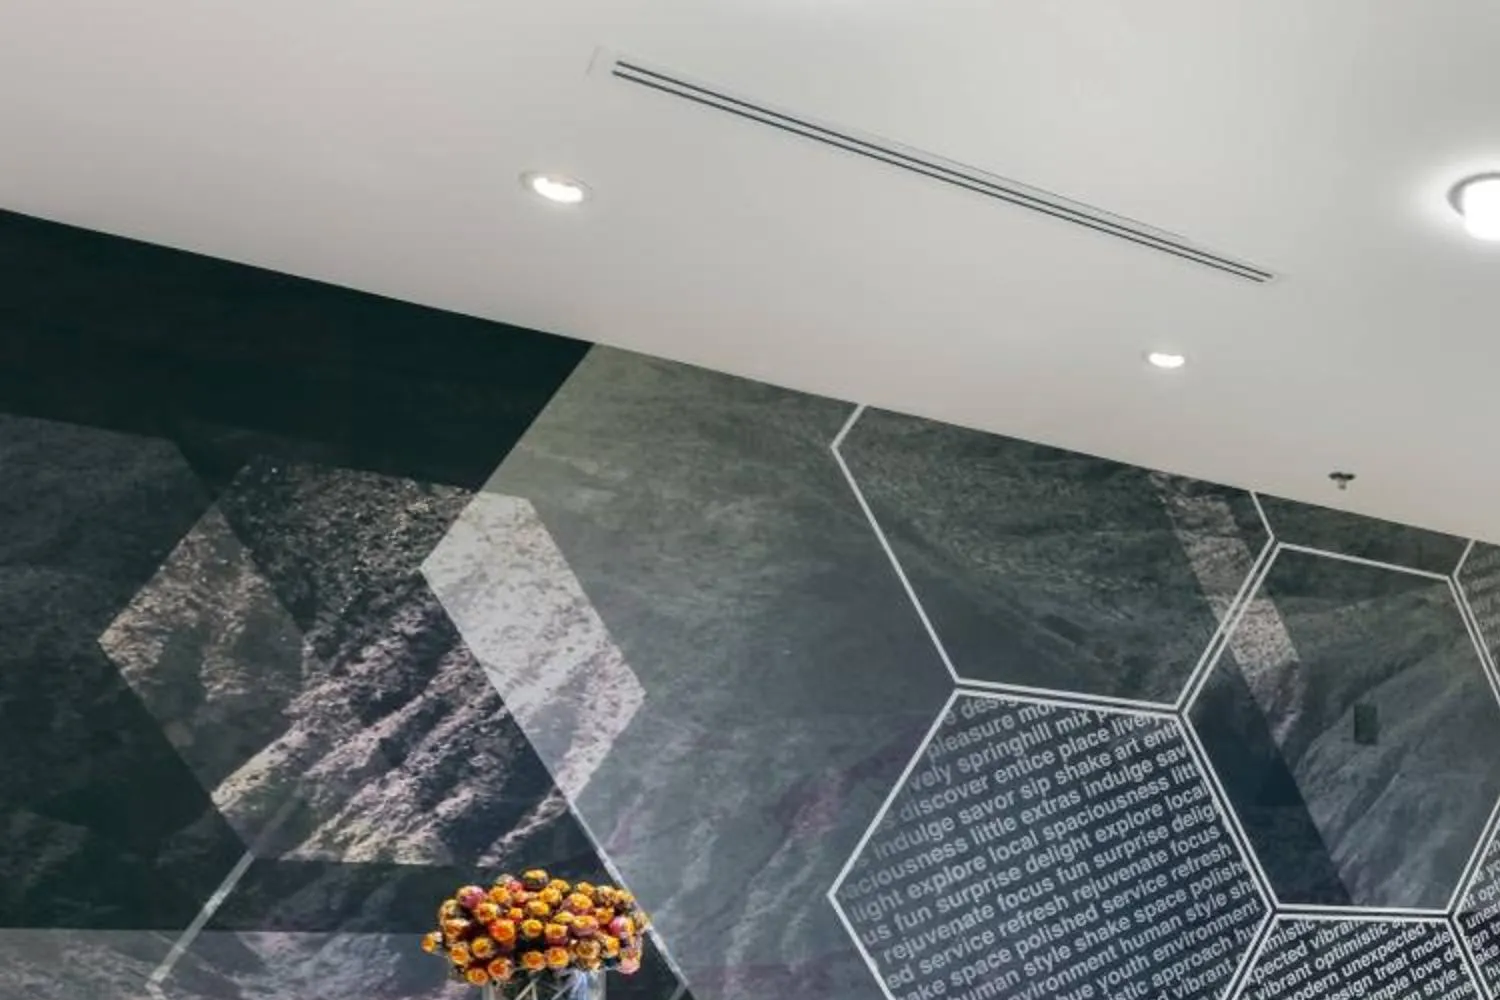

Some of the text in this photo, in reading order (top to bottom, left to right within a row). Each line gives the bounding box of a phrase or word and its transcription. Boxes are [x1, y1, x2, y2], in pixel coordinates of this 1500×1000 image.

[896, 775, 991, 823] discover
[993, 749, 1056, 784] entice
[1057, 727, 1112, 763] place
[925, 714, 1015, 765] pleasure
[956, 720, 1053, 773] springhill
[1054, 709, 1092, 735] mix
[871, 816, 956, 860] indulge
[957, 790, 1017, 825] savor
[1018, 776, 1054, 799] sip
[1053, 751, 1113, 786] shake
[1113, 735, 1141, 760] art
[968, 816, 1018, 845] little
[1019, 788, 1082, 825] extras
[1081, 758, 1154, 798] indulge
[892, 905, 933, 931] fun
[934, 865, 1024, 914] surprise
[1021, 831, 1093, 874] delight
[1093, 802, 1165, 843] explore
[906, 855, 988, 900] explore
[987, 827, 1039, 863] local
[1042, 775, 1170, 841] spaciousness
[883, 903, 996, 965] rejuvenate
[994, 876, 1056, 912] focus
[1053, 860, 1091, 885] fun
[1092, 824, 1170, 869] surprise
[918, 929, 997, 975] service
[997, 890, 1070, 937] refresh
[1071, 848, 1170, 903] rejuvenate
[1167, 824, 1221, 857] focus
[949, 947, 1014, 987] space
[1014, 901, 1099, 960] polished
[1100, 872, 1169, 914] service
[1169, 837, 1232, 881] refresh
[1117, 913, 1183, 954] human
[1183, 891, 1228, 922] style
[1022, 944, 1073, 978] style
[1073, 915, 1132, 953] shake
[1132, 887, 1188, 924] space
[1095, 949, 1150, 995] youth
[1150, 893, 1261, 961] environment
[1149, 930, 1233, 988] approach
[1314, 920, 1389, 971] optimistic
[1341, 921, 1426, 977] unexpected
[1374, 950, 1410, 981] treat
[1409, 955, 1442, 982] love
[1171, 954, 1234, 1000] vibrant
[1423, 967, 1458, 995] style
